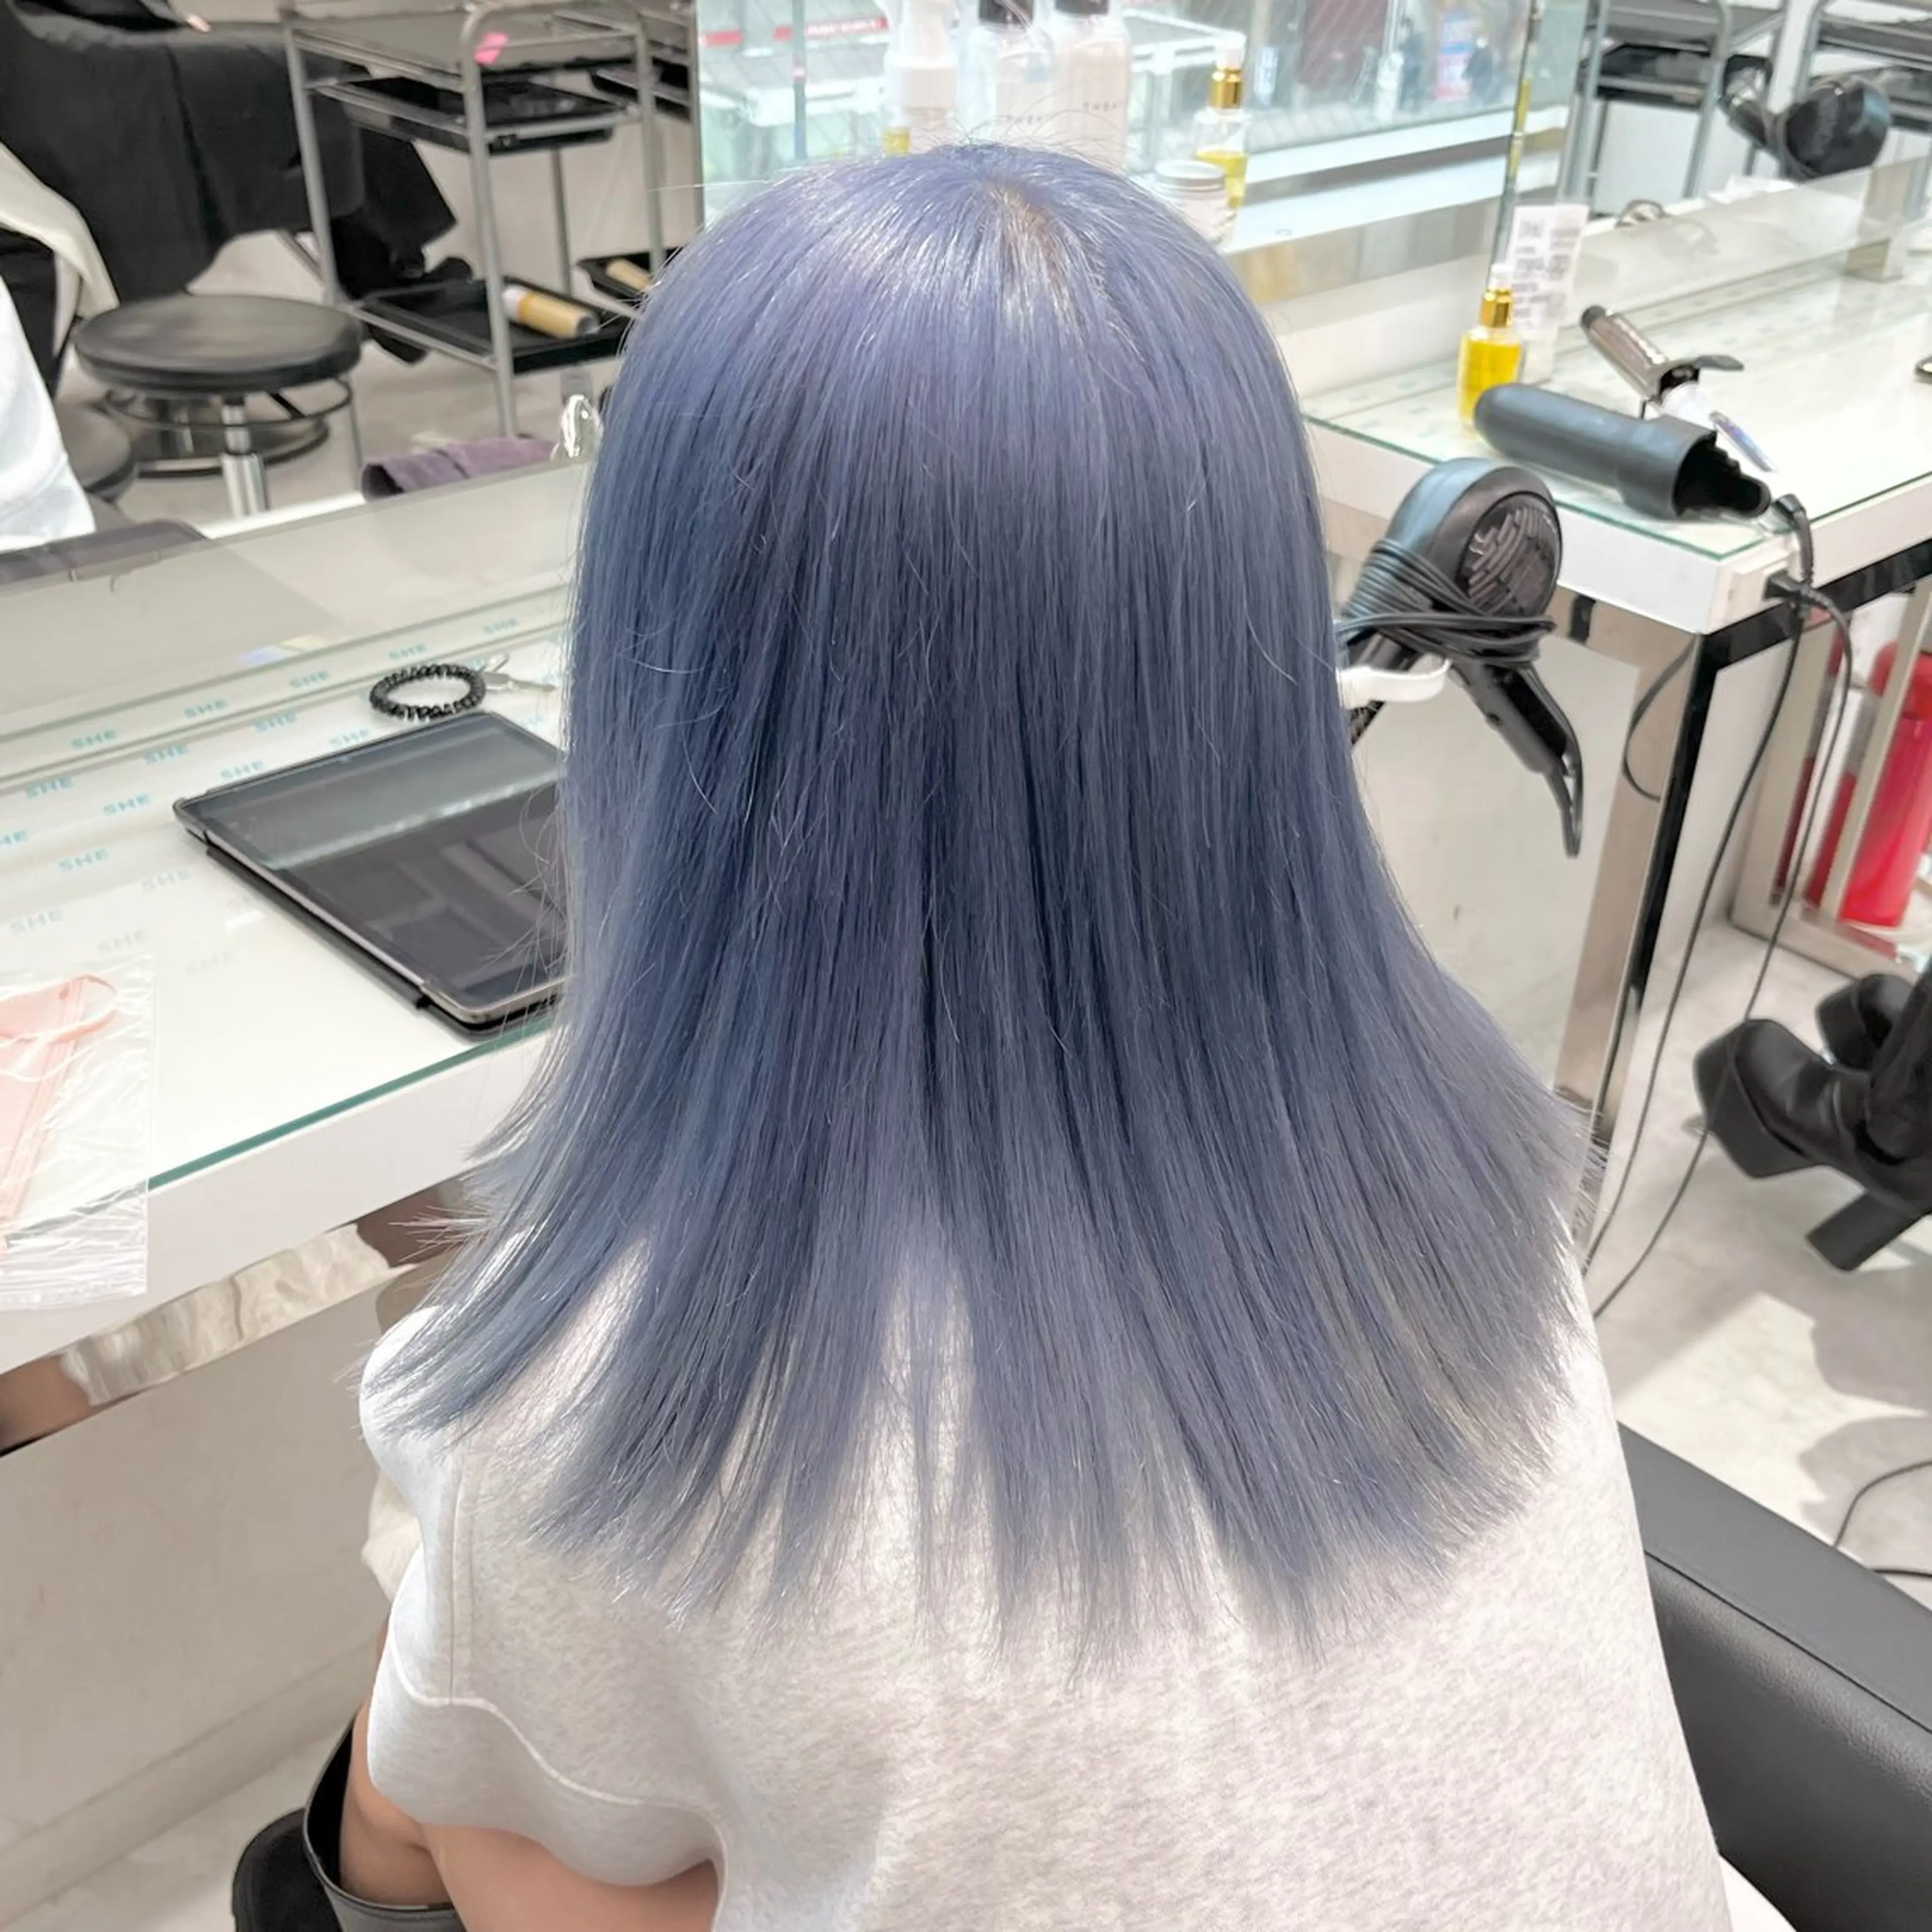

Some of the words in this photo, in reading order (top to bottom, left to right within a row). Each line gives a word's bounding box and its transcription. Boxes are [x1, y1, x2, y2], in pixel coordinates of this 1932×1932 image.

[290, 671, 329, 688] SHE
[184, 699, 227, 718] SHE
[255, 713, 297, 731] SHE
[71, 731, 116, 749] SHE
[330, 729, 370, 747] SHE
[143, 744, 189, 763] SHE
[220, 761, 263, 780] SHE
[26, 778, 73, 797] SHE
[103, 794, 150, 815] SHE
[0, 831, 26, 845] HE
[59, 849, 108, 872] SHE
[141, 869, 191, 892] SHE
[11, 910, 61, 933] SHE
